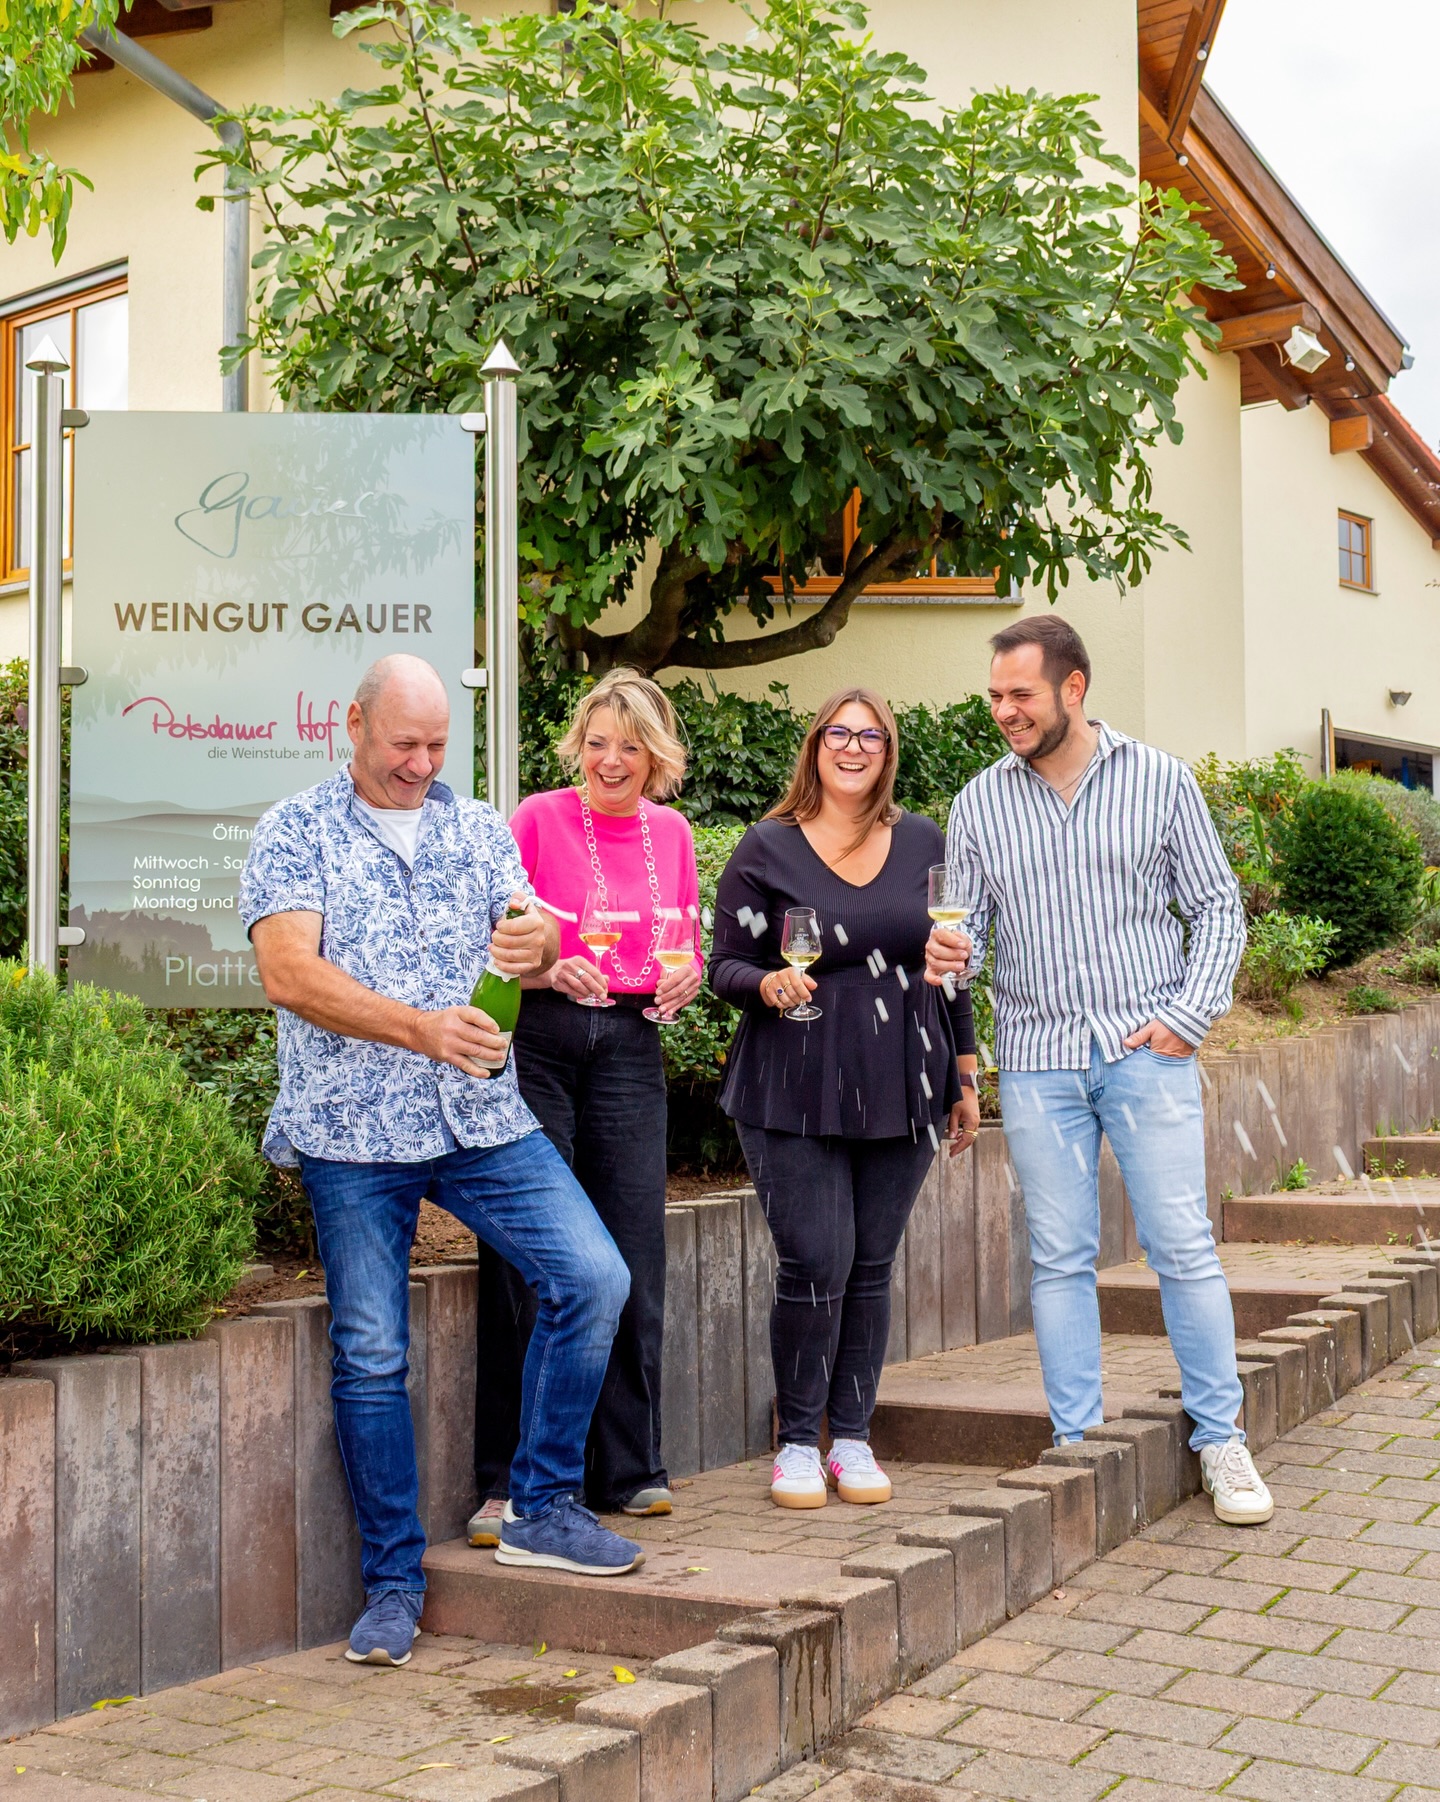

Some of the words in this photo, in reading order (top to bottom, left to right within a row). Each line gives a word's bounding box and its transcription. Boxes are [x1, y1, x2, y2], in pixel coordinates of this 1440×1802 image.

[114, 602, 288, 632] WEINGUT
[302, 602, 432, 633] GAUER
[122, 697, 278, 740] Potsdamer
[296, 691, 340, 762] Hof
[207, 747, 228, 759] die
[232, 747, 300, 759] Weinstube
[303, 749, 324, 759] am
[133, 855, 209, 870] Mittwoch
[223, 855, 248, 870] Sa
[132, 875, 201, 892] Sonntag
[132, 894, 198, 912] Montag
[202, 894, 234, 909] und
